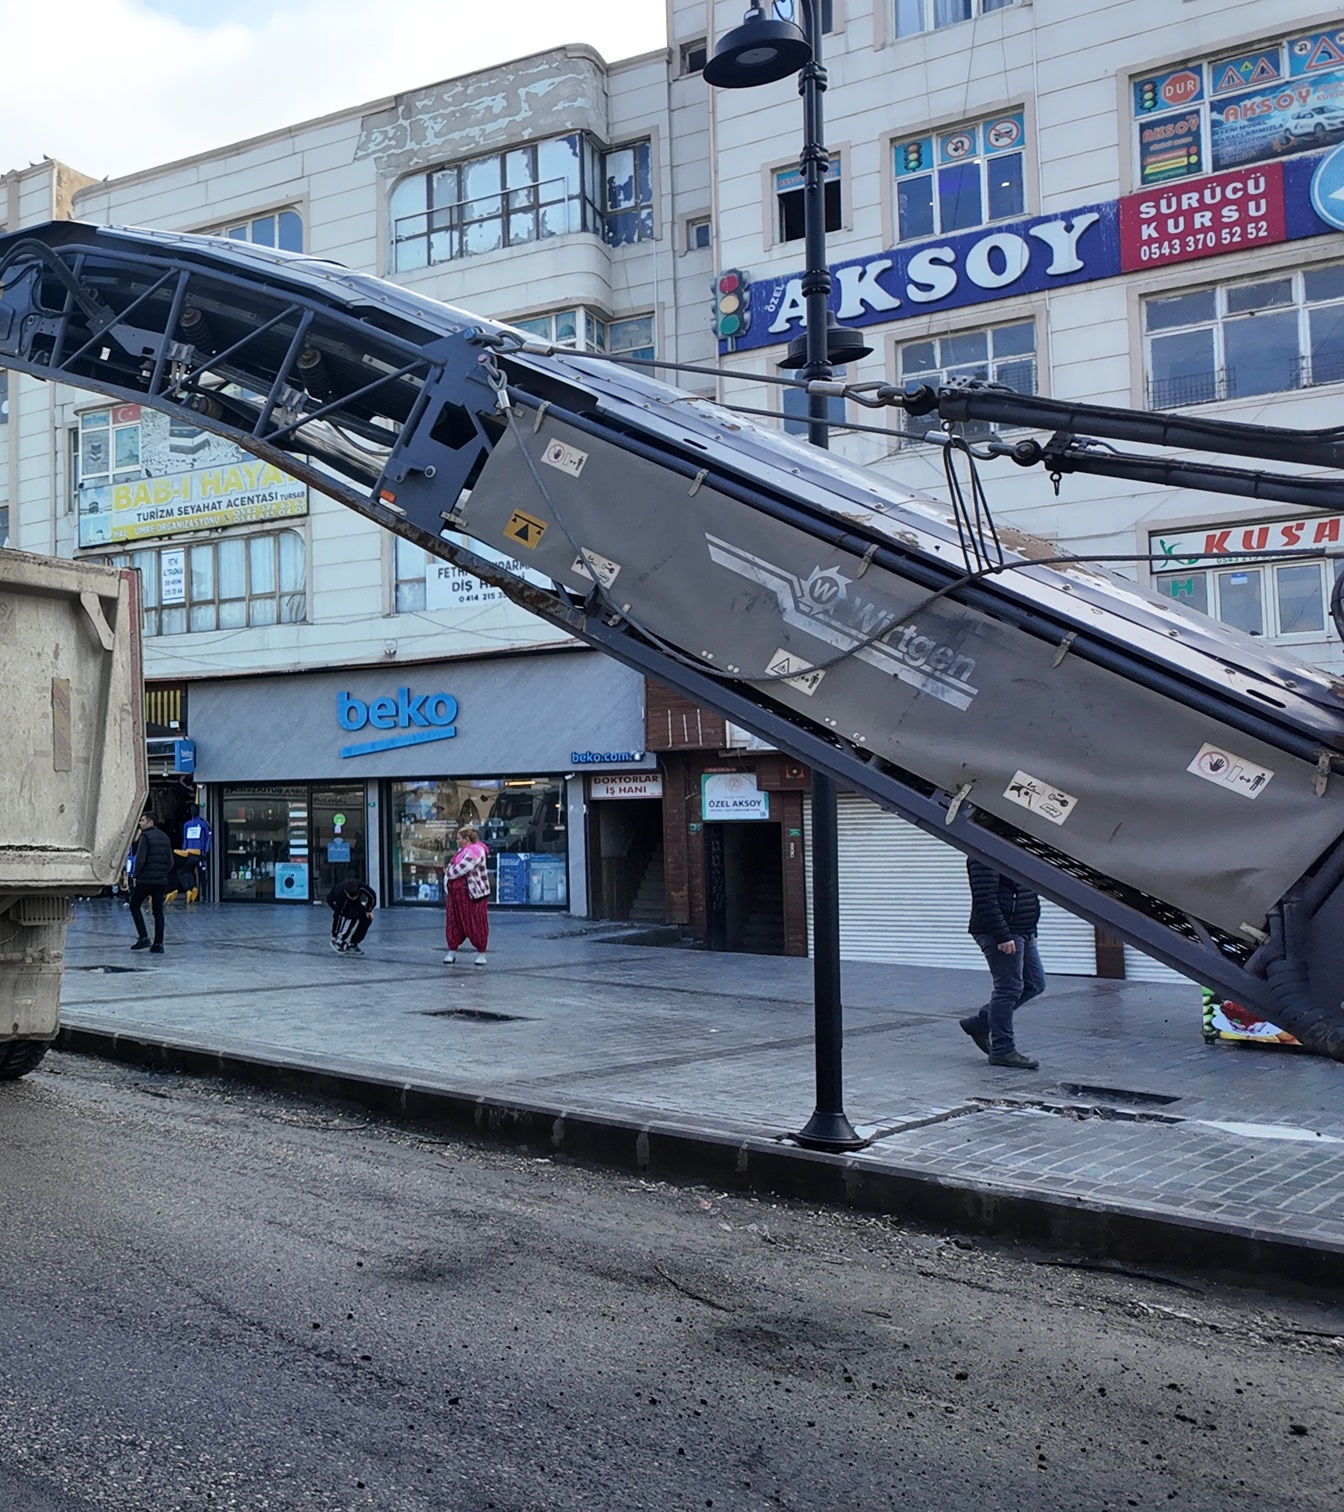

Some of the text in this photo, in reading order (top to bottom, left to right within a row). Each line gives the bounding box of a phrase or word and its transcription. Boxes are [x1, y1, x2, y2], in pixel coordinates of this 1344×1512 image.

[1165, 79, 1196, 97] DUR
[1224, 88, 1312, 122] AKSOY
[1143, 116, 1200, 143] AKSOY
[1140, 173, 1266, 218] SÜRÜCÜ
[1141, 199, 1267, 240] KURSU
[1141, 221, 1268, 261] 0543 370 52 52
[768, 212, 1100, 334] AKSOY
[765, 284, 785, 313] ÖZEL
[200, 457, 301, 498] HAYA
[136, 507, 175, 522] TURİZM
[177, 500, 223, 517] SEYAHAT
[226, 491, 278, 509] ACENTASI
[452, 579, 473, 593] DİŞ
[465, 593, 479, 602] 414
[482, 592, 496, 600] 215
[851, 596, 977, 683] Wirtgen
[337, 686, 459, 732] beko
[593, 775, 659, 785] DOKTORLAR
[606, 785, 616, 795] İŞ
[619, 786, 647, 794] HANI
[708, 799, 762, 808] ÖZEL AKSOY
